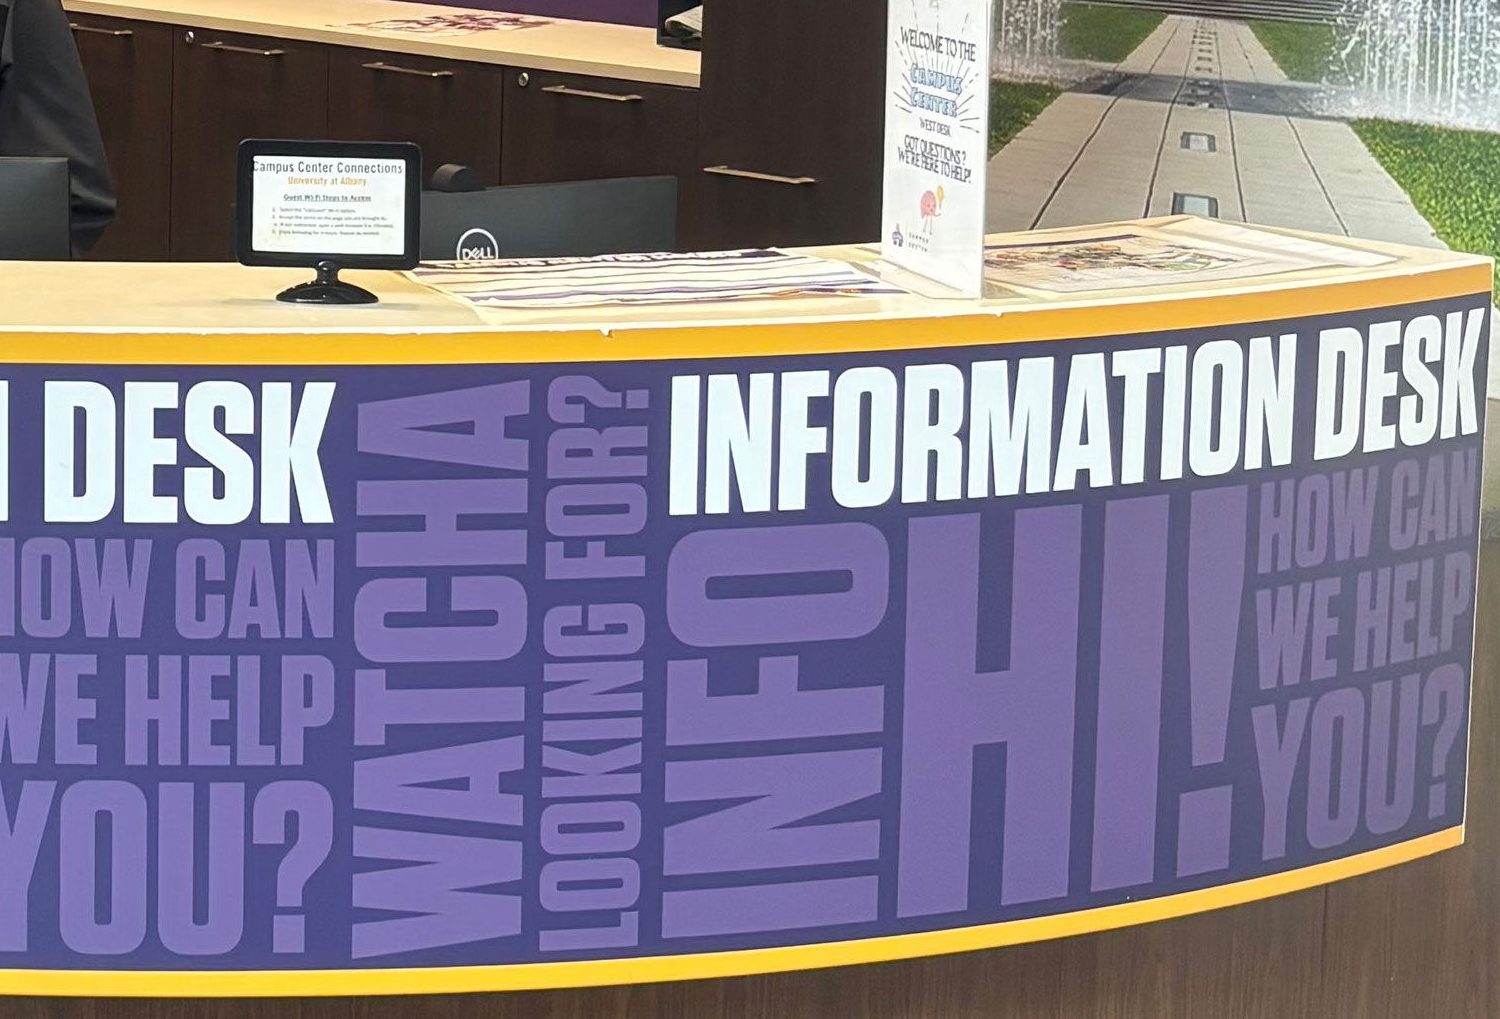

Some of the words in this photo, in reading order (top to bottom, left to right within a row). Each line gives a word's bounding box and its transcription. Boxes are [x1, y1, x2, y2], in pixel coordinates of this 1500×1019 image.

[900, 26, 943, 54] WELCOME
[945, 37, 958, 57] TO
[959, 41, 977, 63] THE
[909, 62, 963, 95] CAMPUS
[904, 134, 920, 150] GOT
[910, 86, 958, 118] CENTER
[919, 118, 936, 133] WEST
[937, 121, 952, 137] DESK
[252, 160, 295, 174] Campus
[298, 161, 334, 174] Center
[337, 161, 403, 174] Connections
[288, 176, 328, 187] University
[330, 177, 338, 186] at
[340, 177, 367, 188] Albany
[921, 153, 940, 174] HERE
[941, 159, 951, 176] TO
[951, 162, 972, 184] HELP!
[462, 246, 494, 260] DELL
[44, 380, 336, 525] DESK
[668, 333, 1297, 516] INFORMATION
[1314, 307, 1485, 462] DESK
[544, 374, 649, 580] FOR?
[1257, 466, 1380, 575] HOW
[1388, 448, 1478, 552] CAN
[175, 538, 335, 640] CAN
[1255, 579, 1342, 691] WE
[1353, 551, 1473, 673] HELP
[124, 654, 336, 766] HELP
[351, 379, 531, 959] WATCHA
[897, 484, 1248, 919] HI!
[539, 602, 646, 952] LOOKING
[661, 522, 890, 939] INFO
[1251, 663, 1466, 862] YOU?
